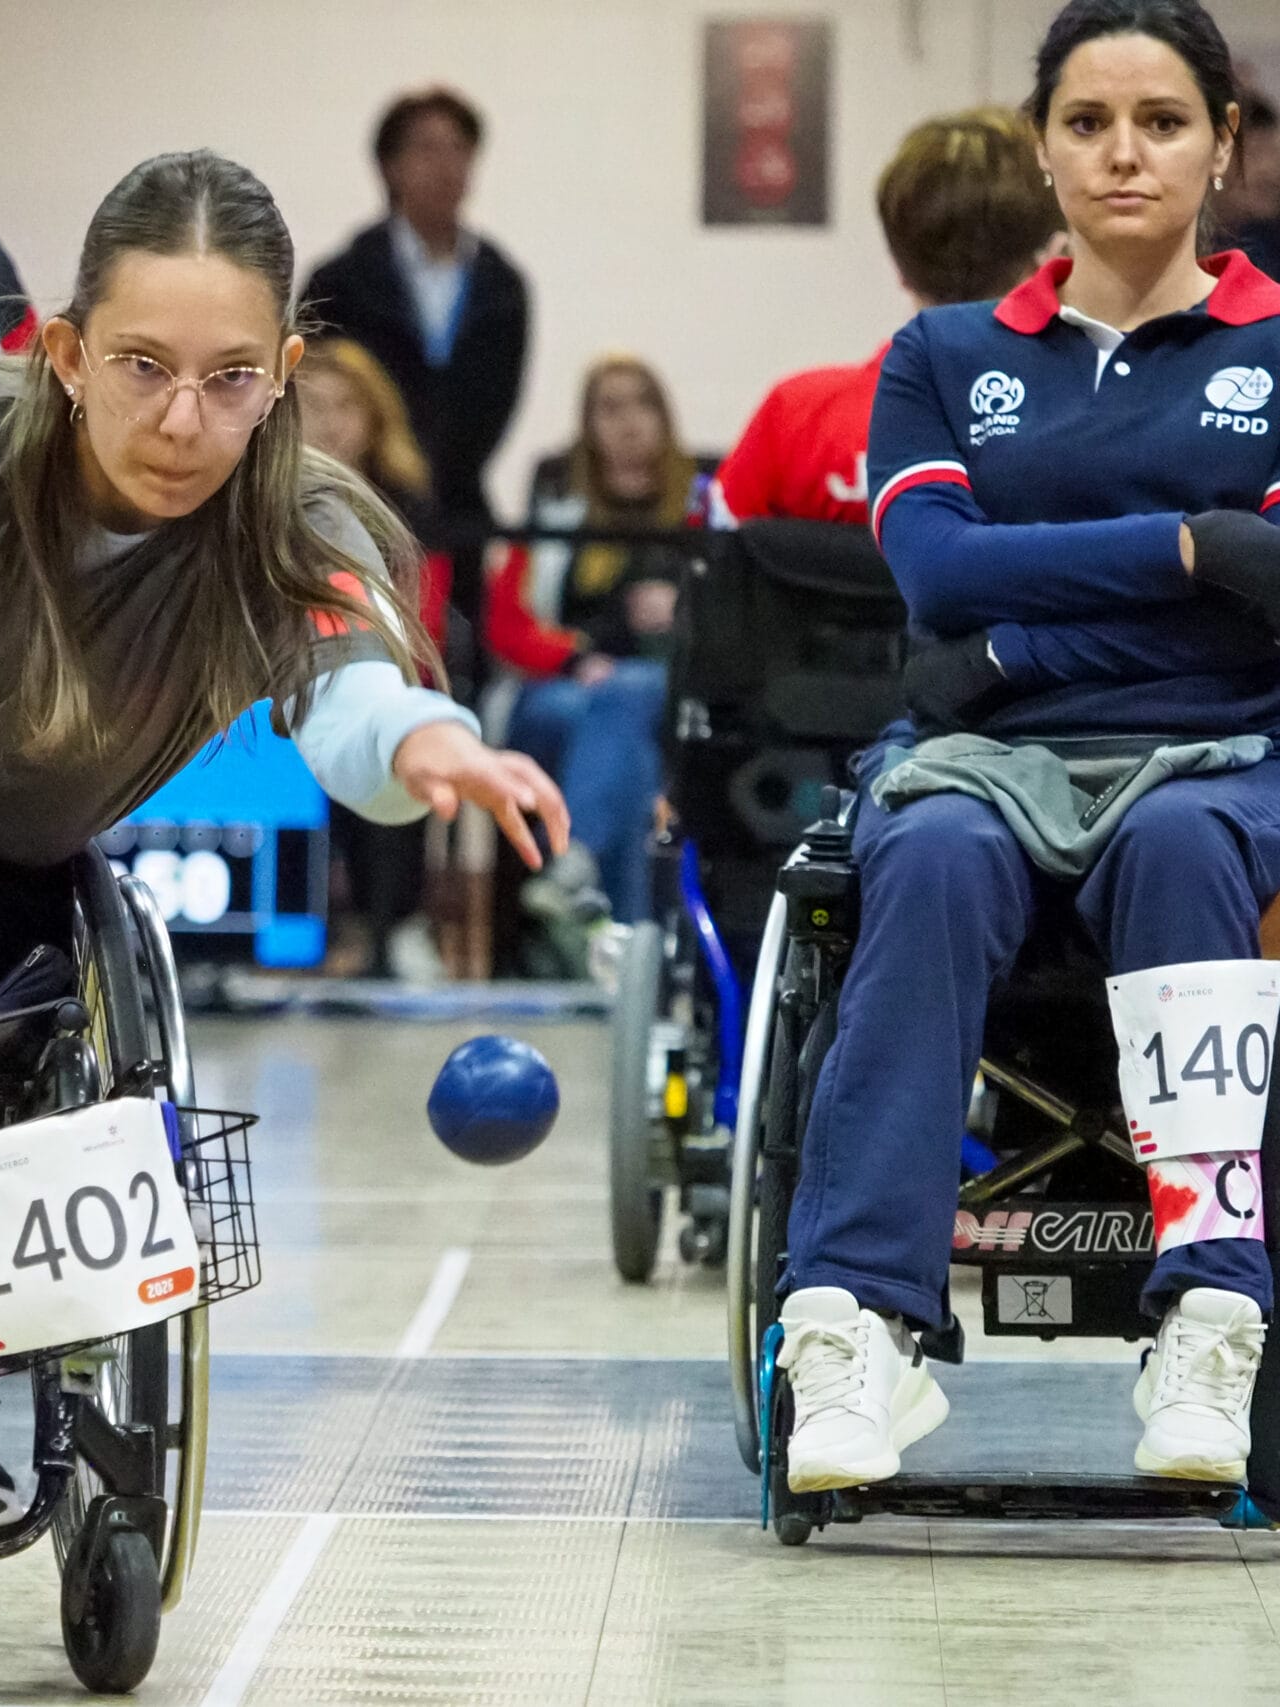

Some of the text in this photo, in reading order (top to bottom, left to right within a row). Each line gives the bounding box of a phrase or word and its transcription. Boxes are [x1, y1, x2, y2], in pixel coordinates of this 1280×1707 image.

[1200, 410, 1269, 435] FPDD
[969, 425, 1017, 447] POUGAL
[1215, 1159, 1256, 1220] C
